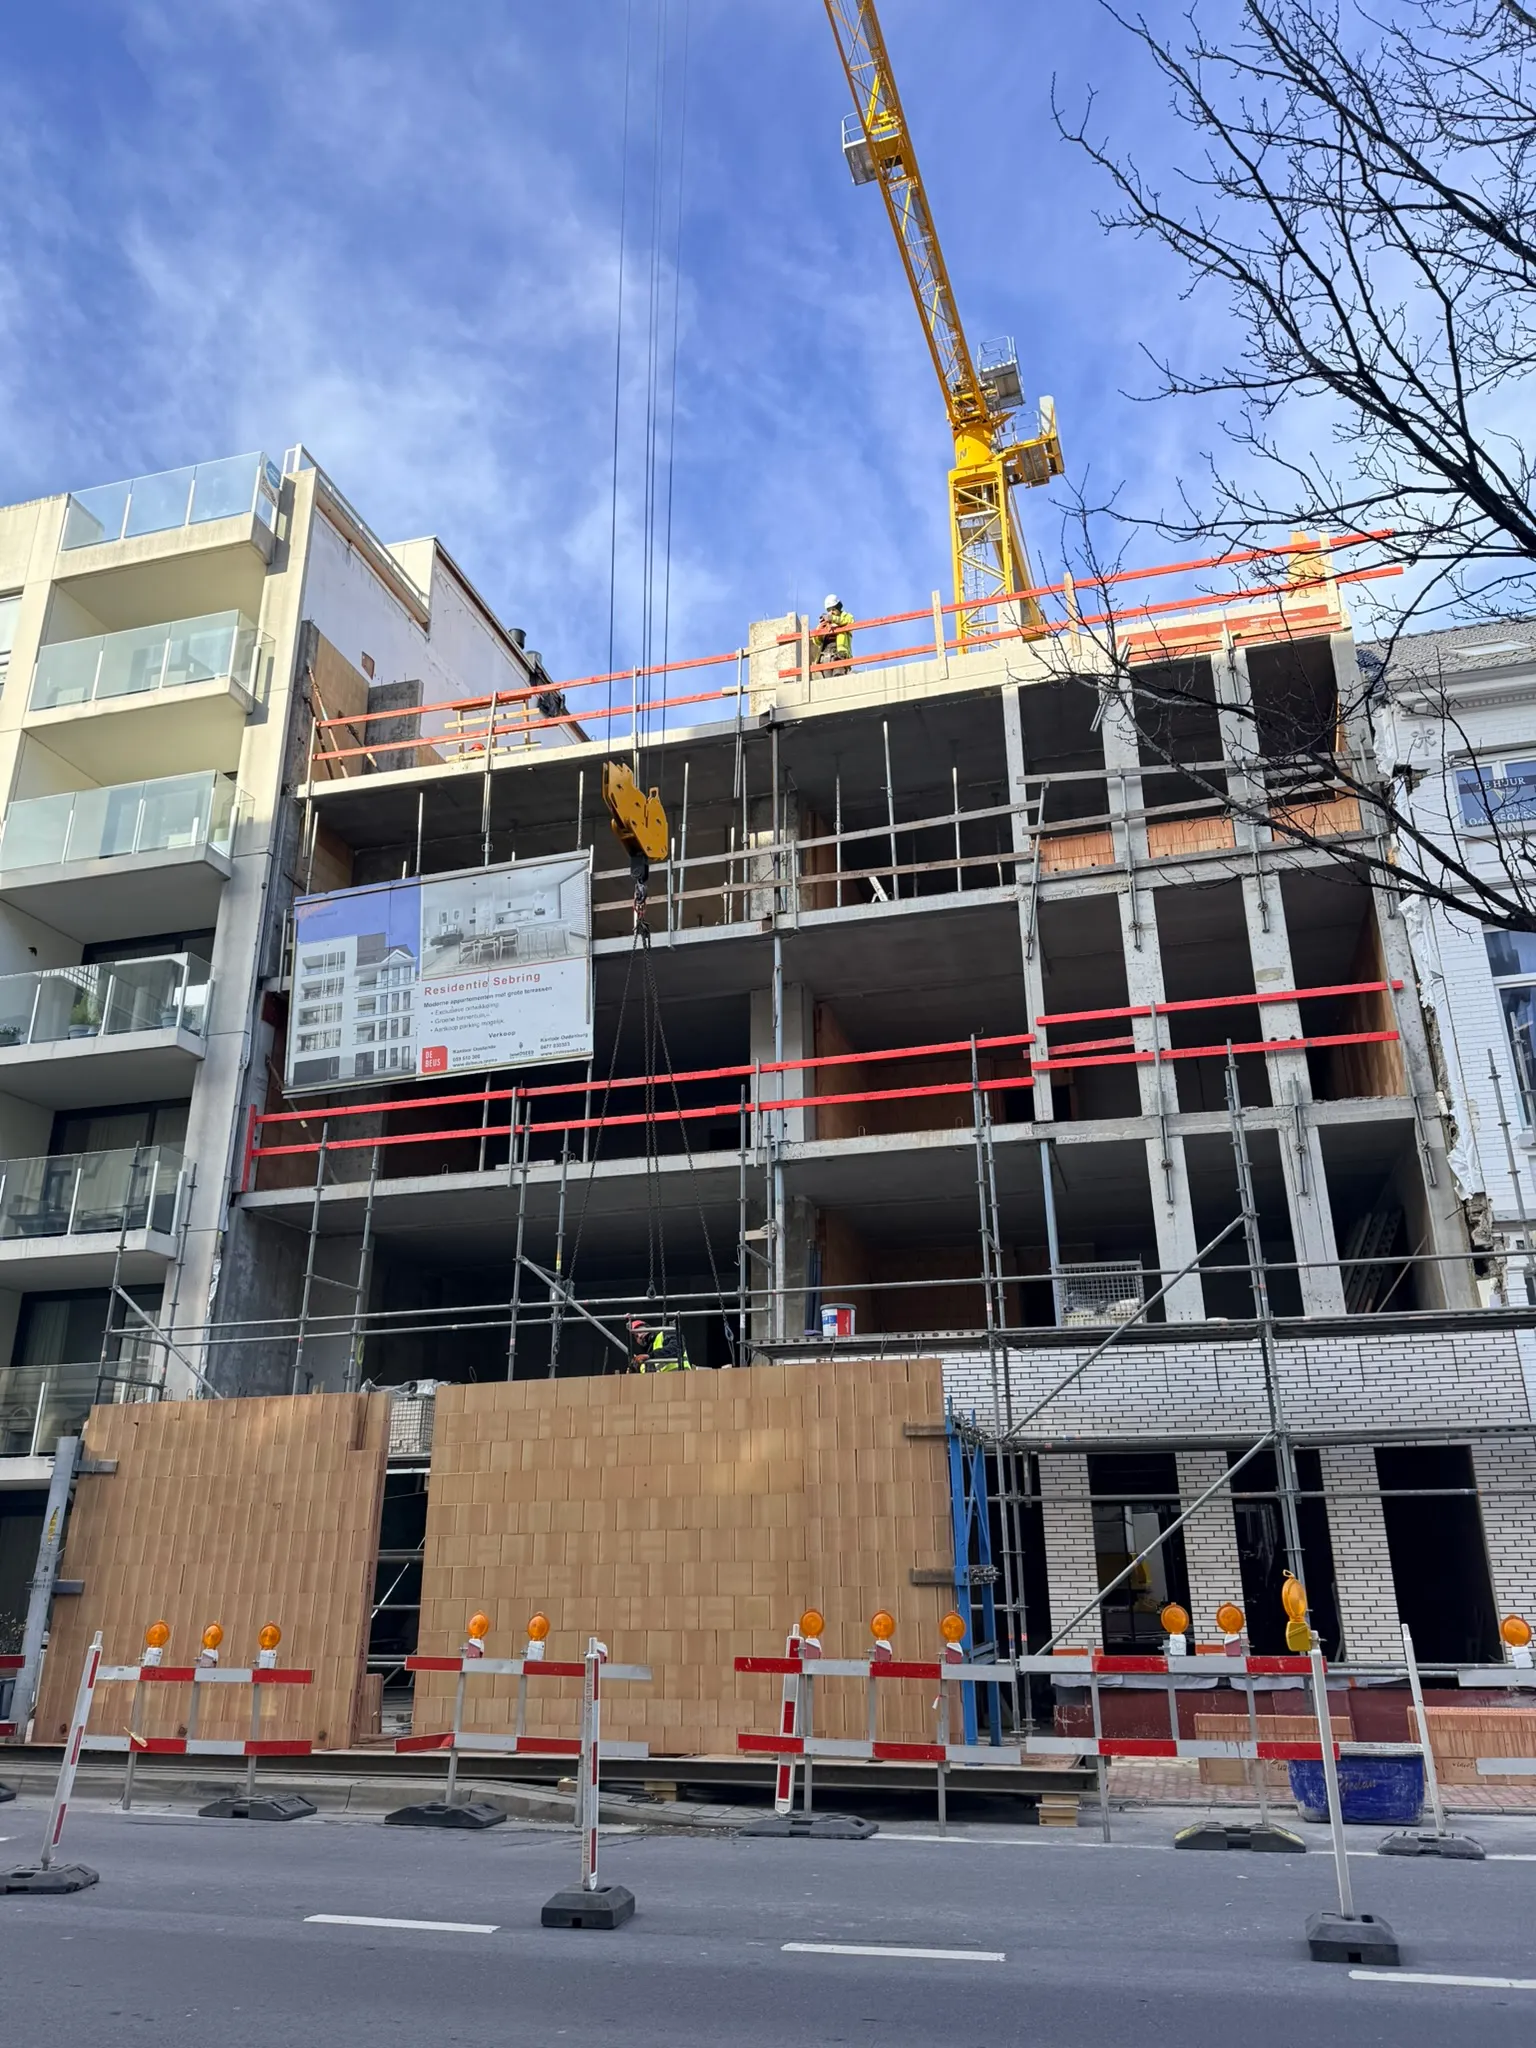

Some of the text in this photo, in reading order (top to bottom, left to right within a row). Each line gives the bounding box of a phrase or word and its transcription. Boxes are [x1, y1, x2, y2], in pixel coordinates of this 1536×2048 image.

[1475, 777, 1526, 791] TE HUUR
[424, 973, 541, 996] Residentie Sebring
[424, 1000, 449, 1008] Moderne
[450, 993, 493, 1004] appartementen
[507, 989, 523, 998] grote
[524, 986, 553, 994] terrassen
[459, 1022, 480, 1030] parking
[488, 1030, 516, 1039] Verkoop
[425, 1050, 433, 1060] DE
[424, 1058, 441, 1068] BEUS
